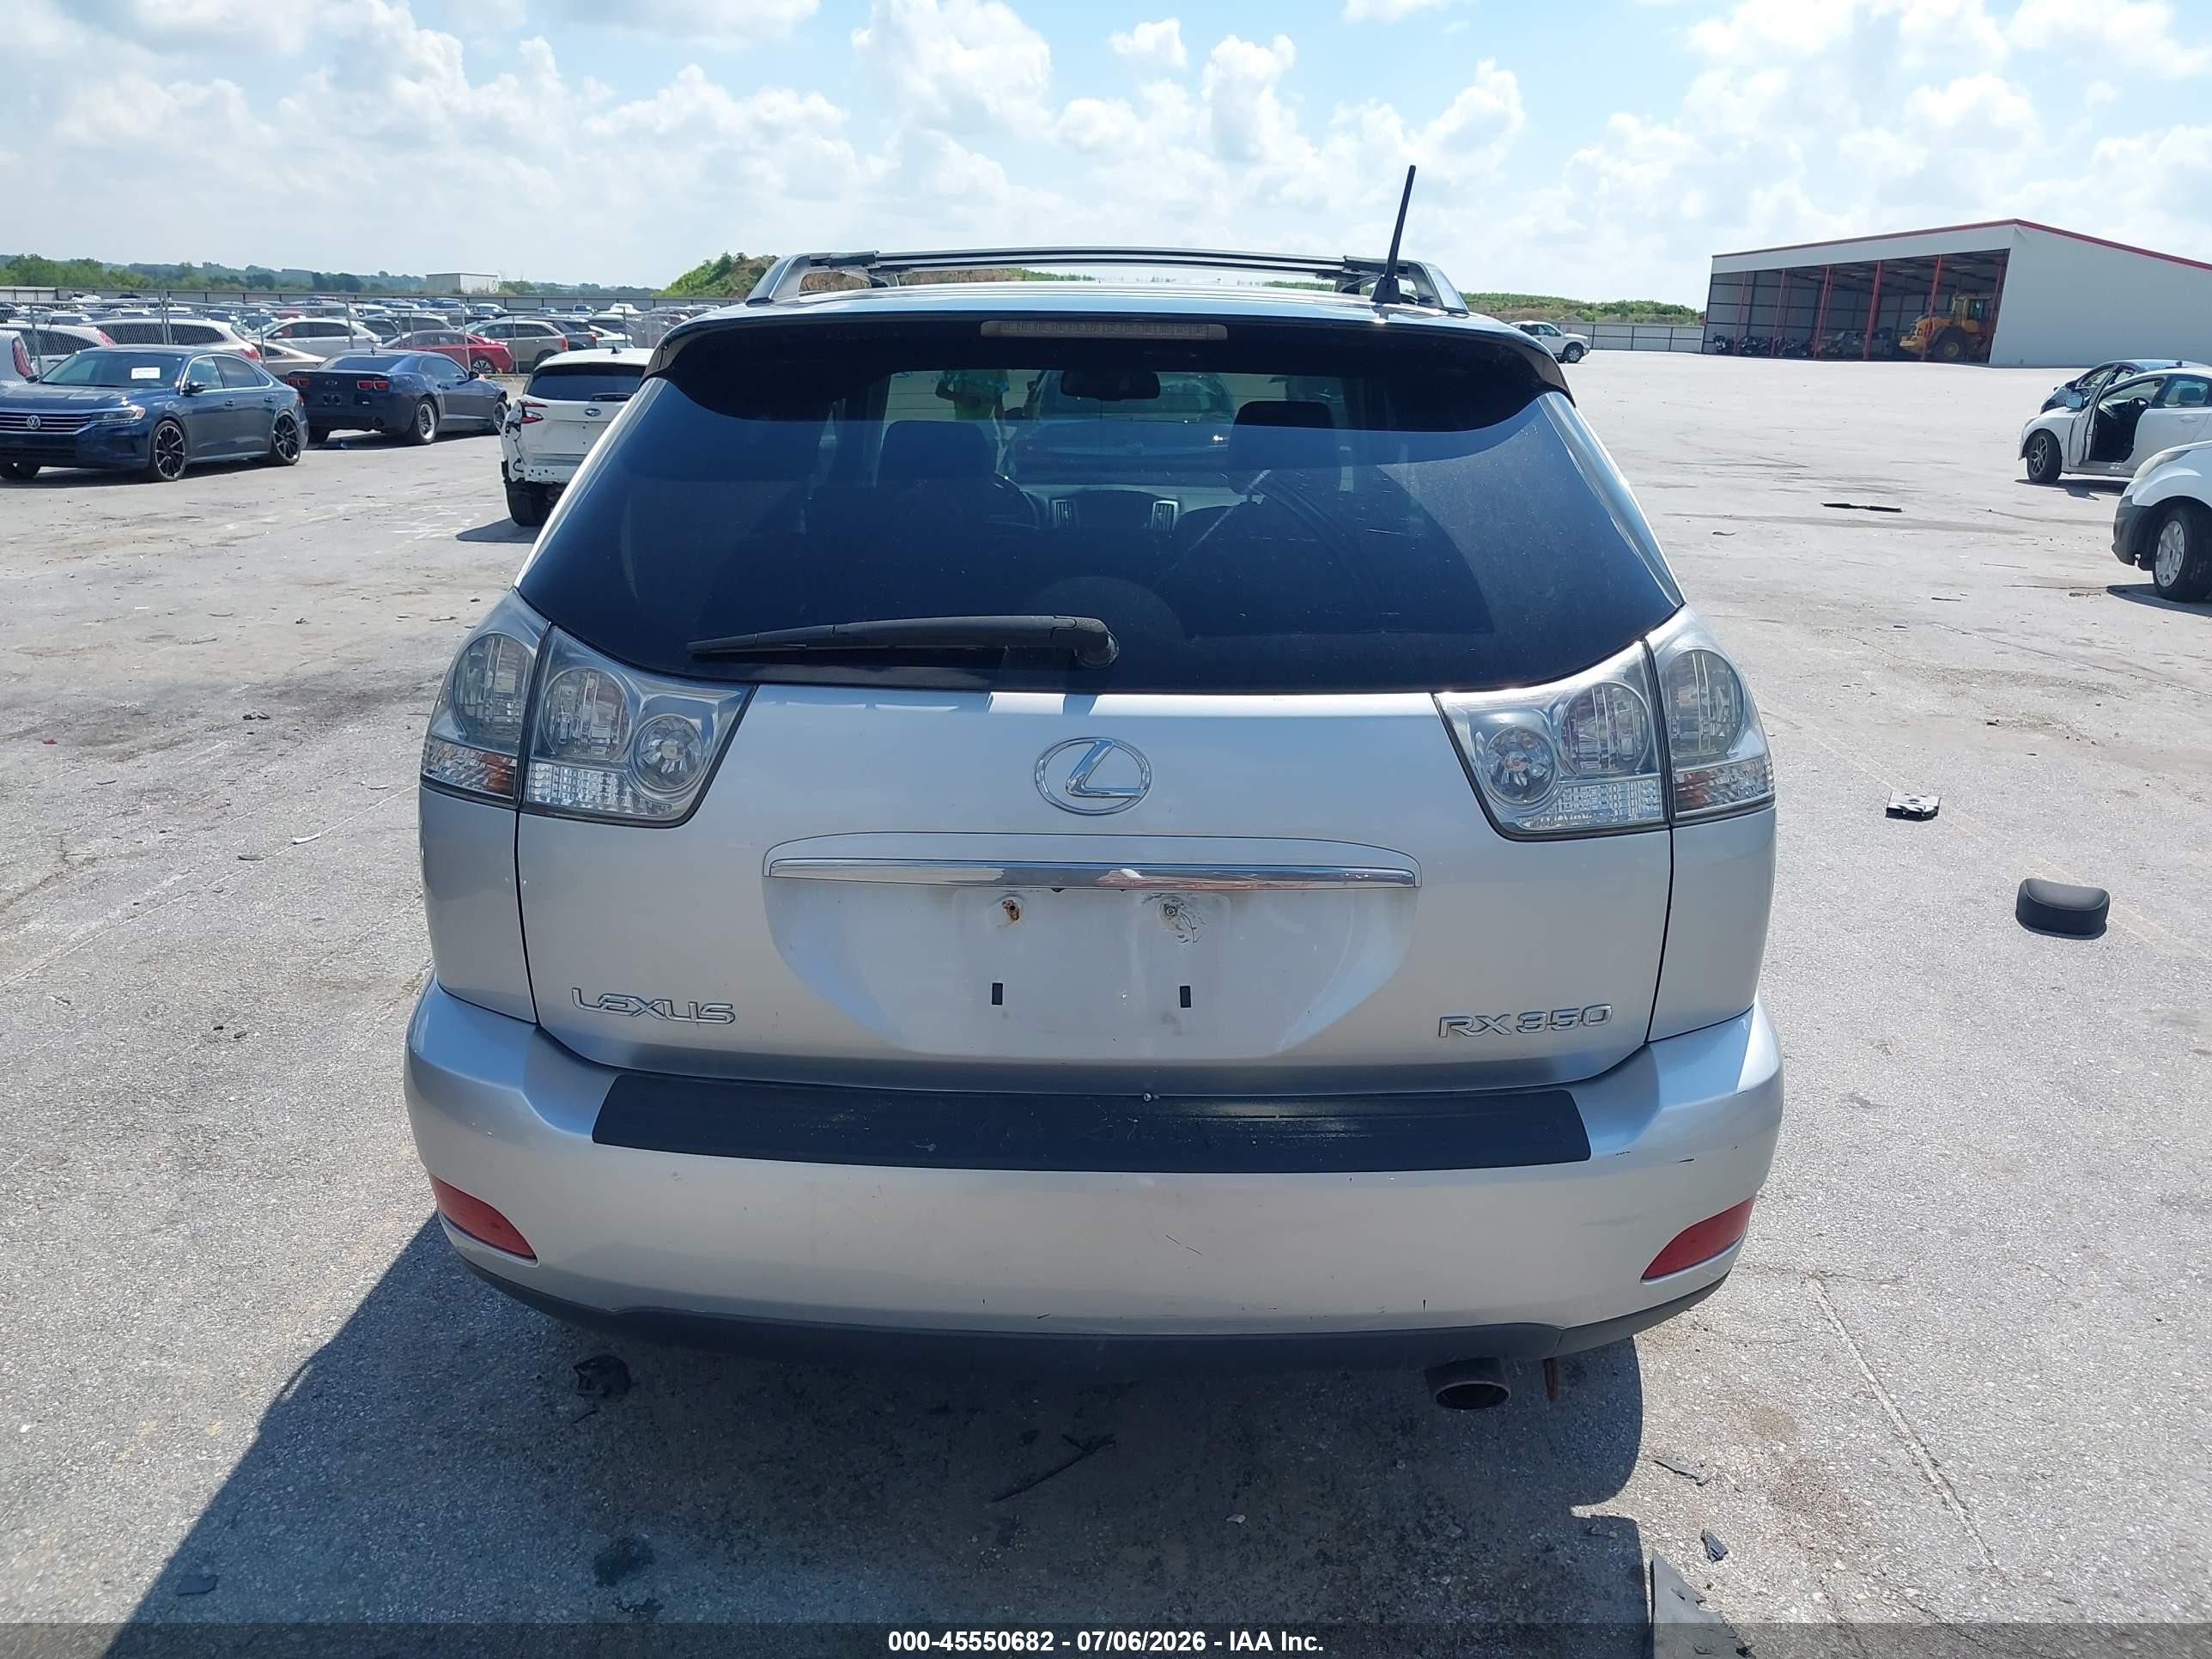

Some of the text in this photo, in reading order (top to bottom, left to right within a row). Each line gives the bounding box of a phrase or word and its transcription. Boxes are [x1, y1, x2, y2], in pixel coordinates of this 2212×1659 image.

[571, 987, 736, 1024] LEXUS
[1438, 1003, 1613, 1038] RX 350
